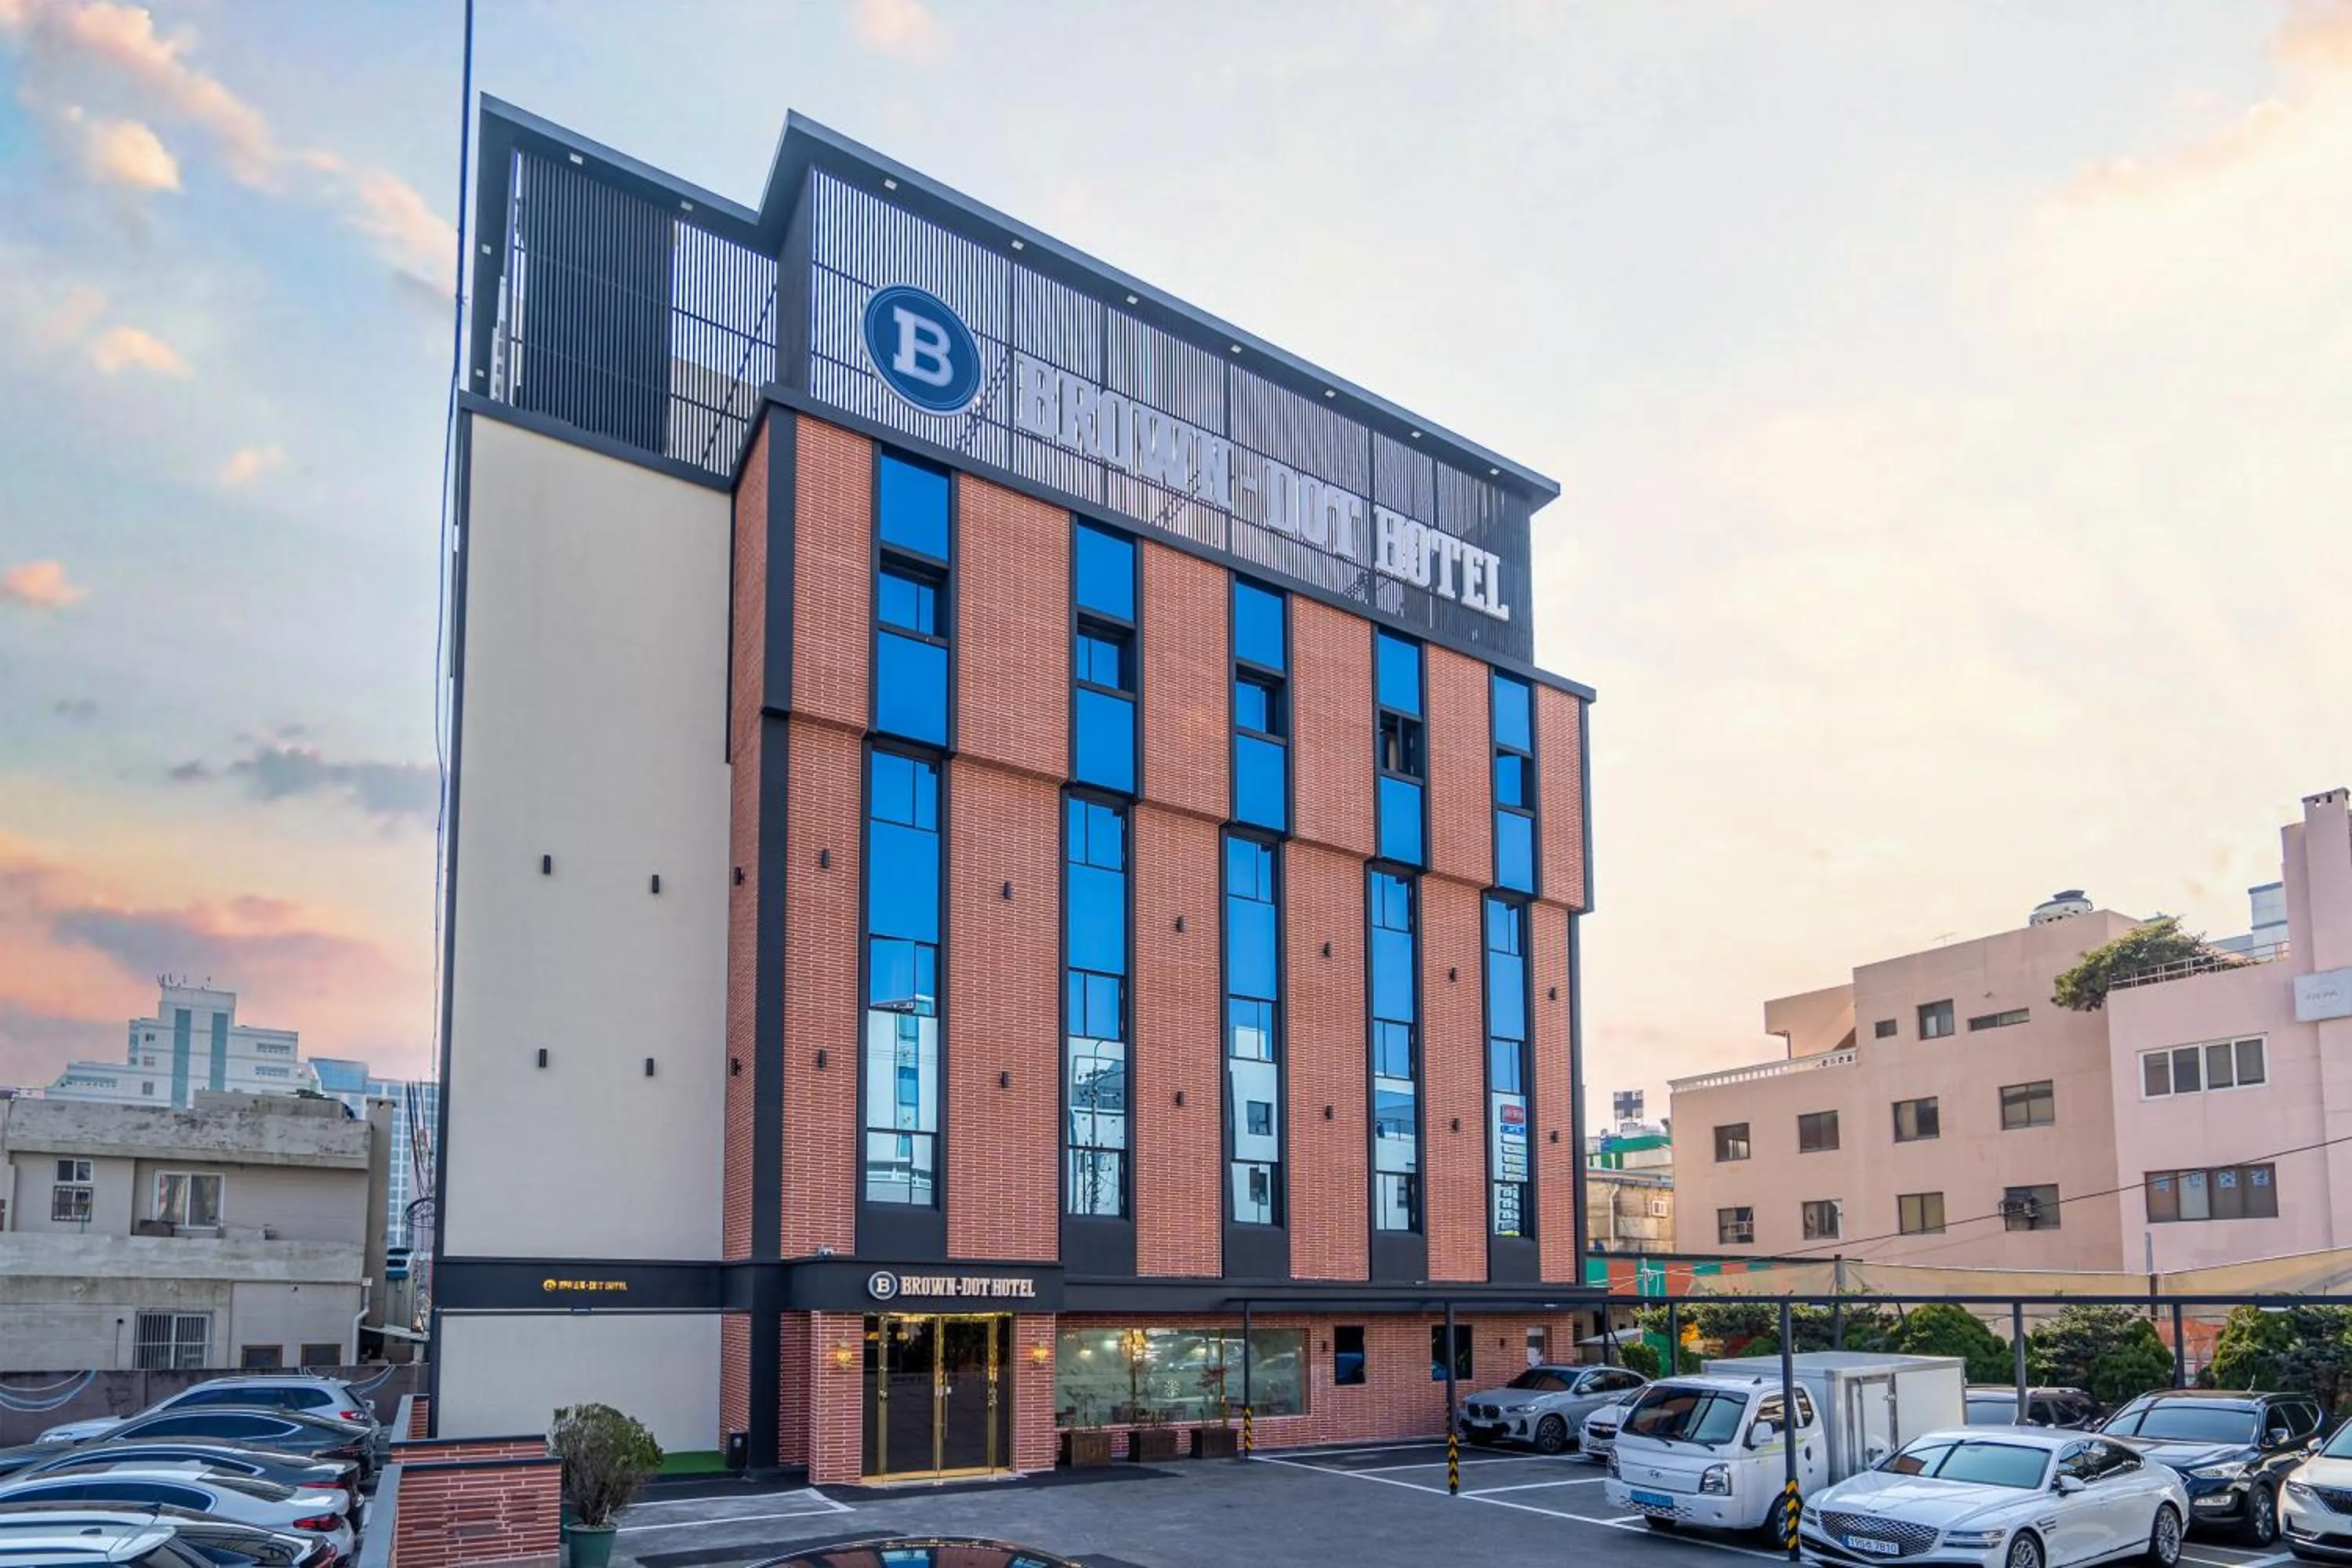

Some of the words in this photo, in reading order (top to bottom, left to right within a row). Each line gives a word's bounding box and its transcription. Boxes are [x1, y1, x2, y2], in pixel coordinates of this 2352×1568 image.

[892, 306, 954, 387] B
[1374, 503, 1509, 622] HOTEL
[876, 1278, 890, 1293] B
[900, 1276, 990, 1297] BROWN-DOT
[991, 1279, 1036, 1298] HOTEL
